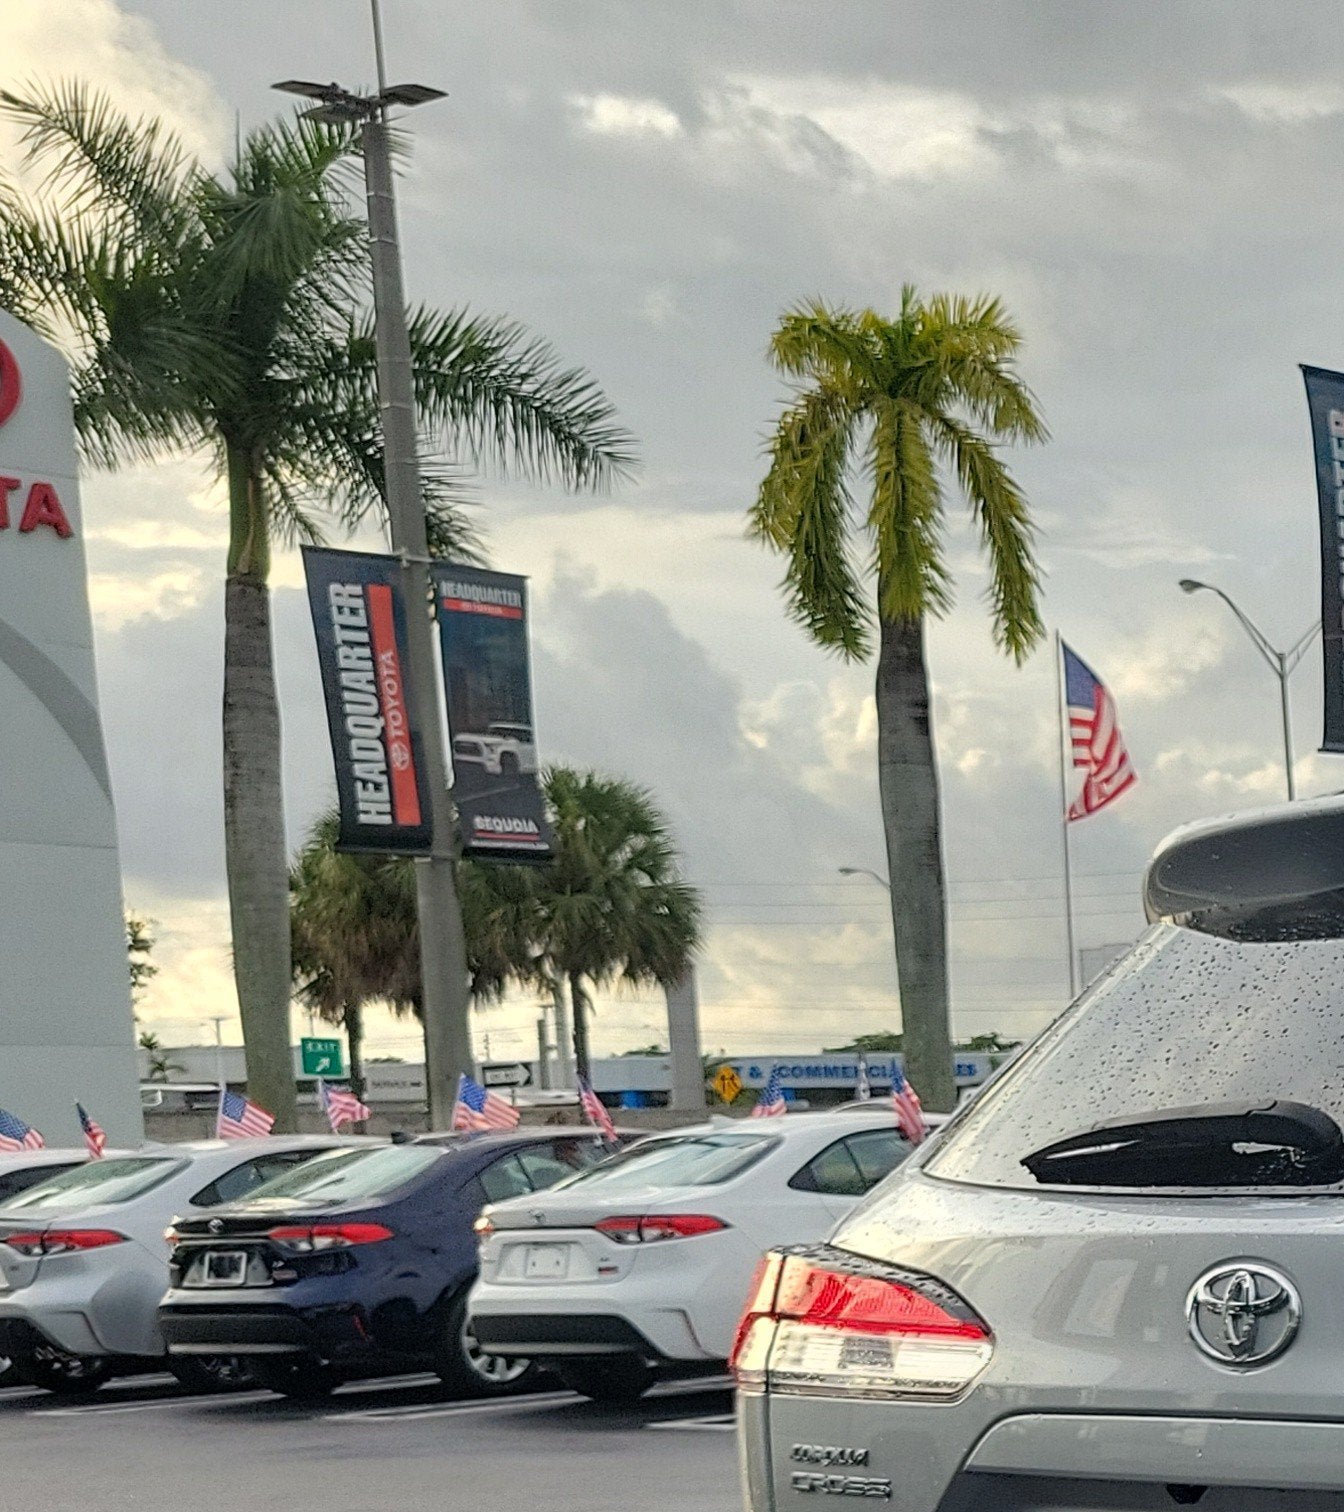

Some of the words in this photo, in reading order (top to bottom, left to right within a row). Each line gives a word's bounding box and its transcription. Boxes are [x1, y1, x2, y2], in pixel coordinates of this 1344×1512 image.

[328, 581, 393, 826] HEADQUARTER
[377, 652, 412, 738] TOYOTA
[474, 814, 540, 834] SEQUOIA
